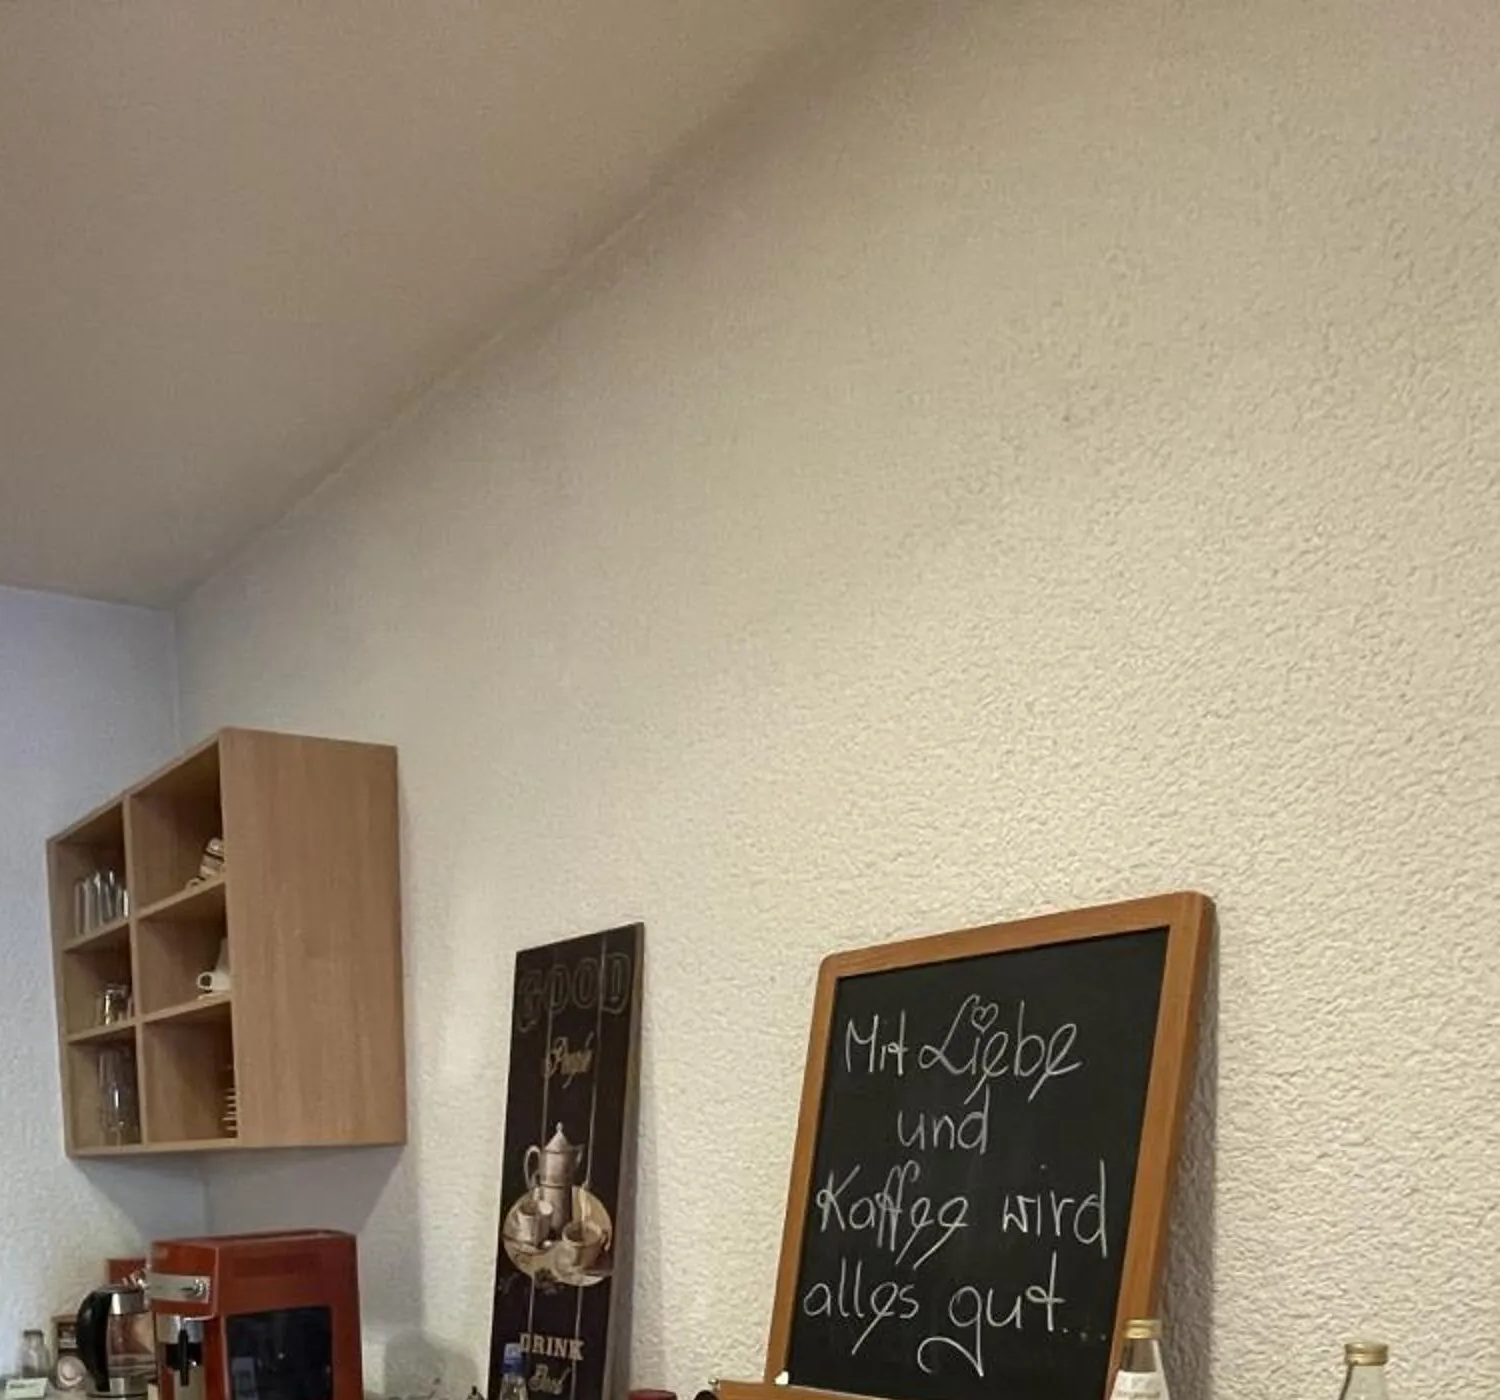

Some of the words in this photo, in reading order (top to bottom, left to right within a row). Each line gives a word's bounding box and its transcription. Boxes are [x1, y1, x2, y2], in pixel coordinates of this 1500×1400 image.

[515, 952, 632, 1033] GOOD
[845, 1009, 908, 1077] Mit
[918, 994, 1083, 1104] Liebe
[897, 1084, 992, 1155] und
[816, 1159, 970, 1269] Kaffee
[1002, 1158, 1109, 1257] wird
[519, 1332, 584, 1361] DRINK
[802, 1257, 919, 1356] alles
